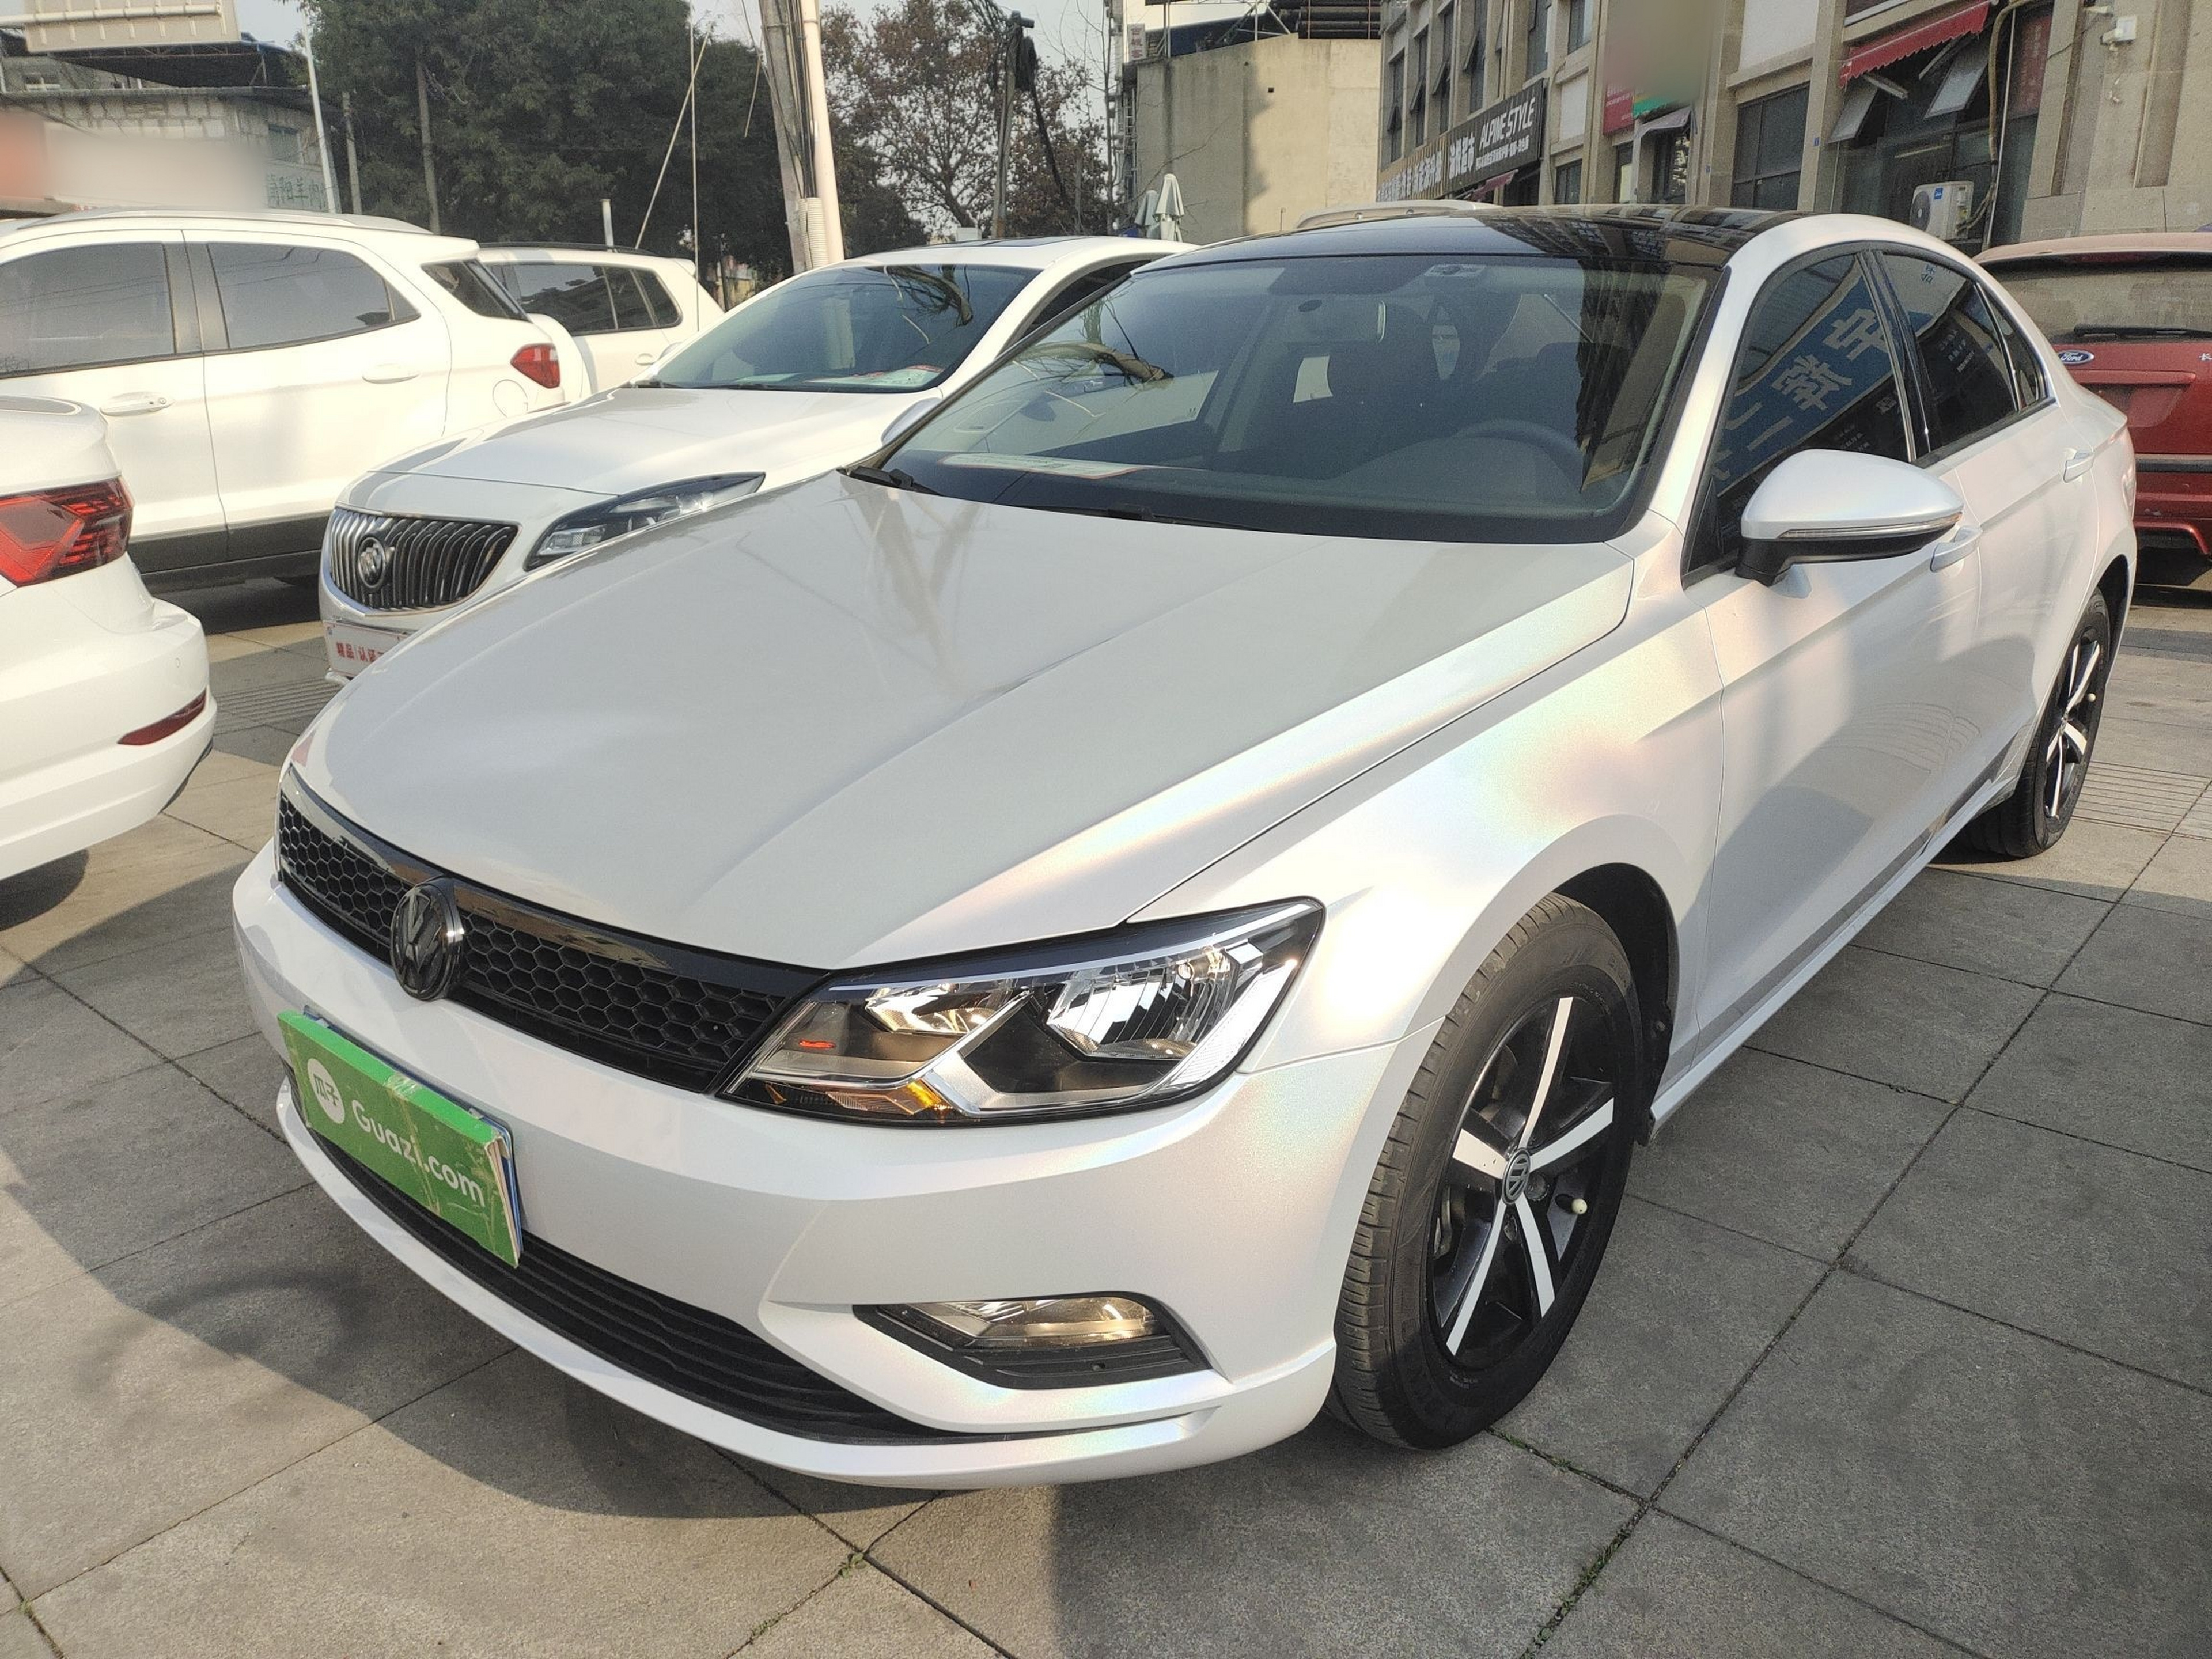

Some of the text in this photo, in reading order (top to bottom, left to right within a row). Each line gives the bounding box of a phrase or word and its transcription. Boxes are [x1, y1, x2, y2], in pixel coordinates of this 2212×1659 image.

[1479, 97, 1536, 151] ALPINE STYLE
[2061, 352, 2084, 361] Ford
[313, 1073, 340, 1105] 瓜子
[352, 1099, 485, 1207] Guazi.com
